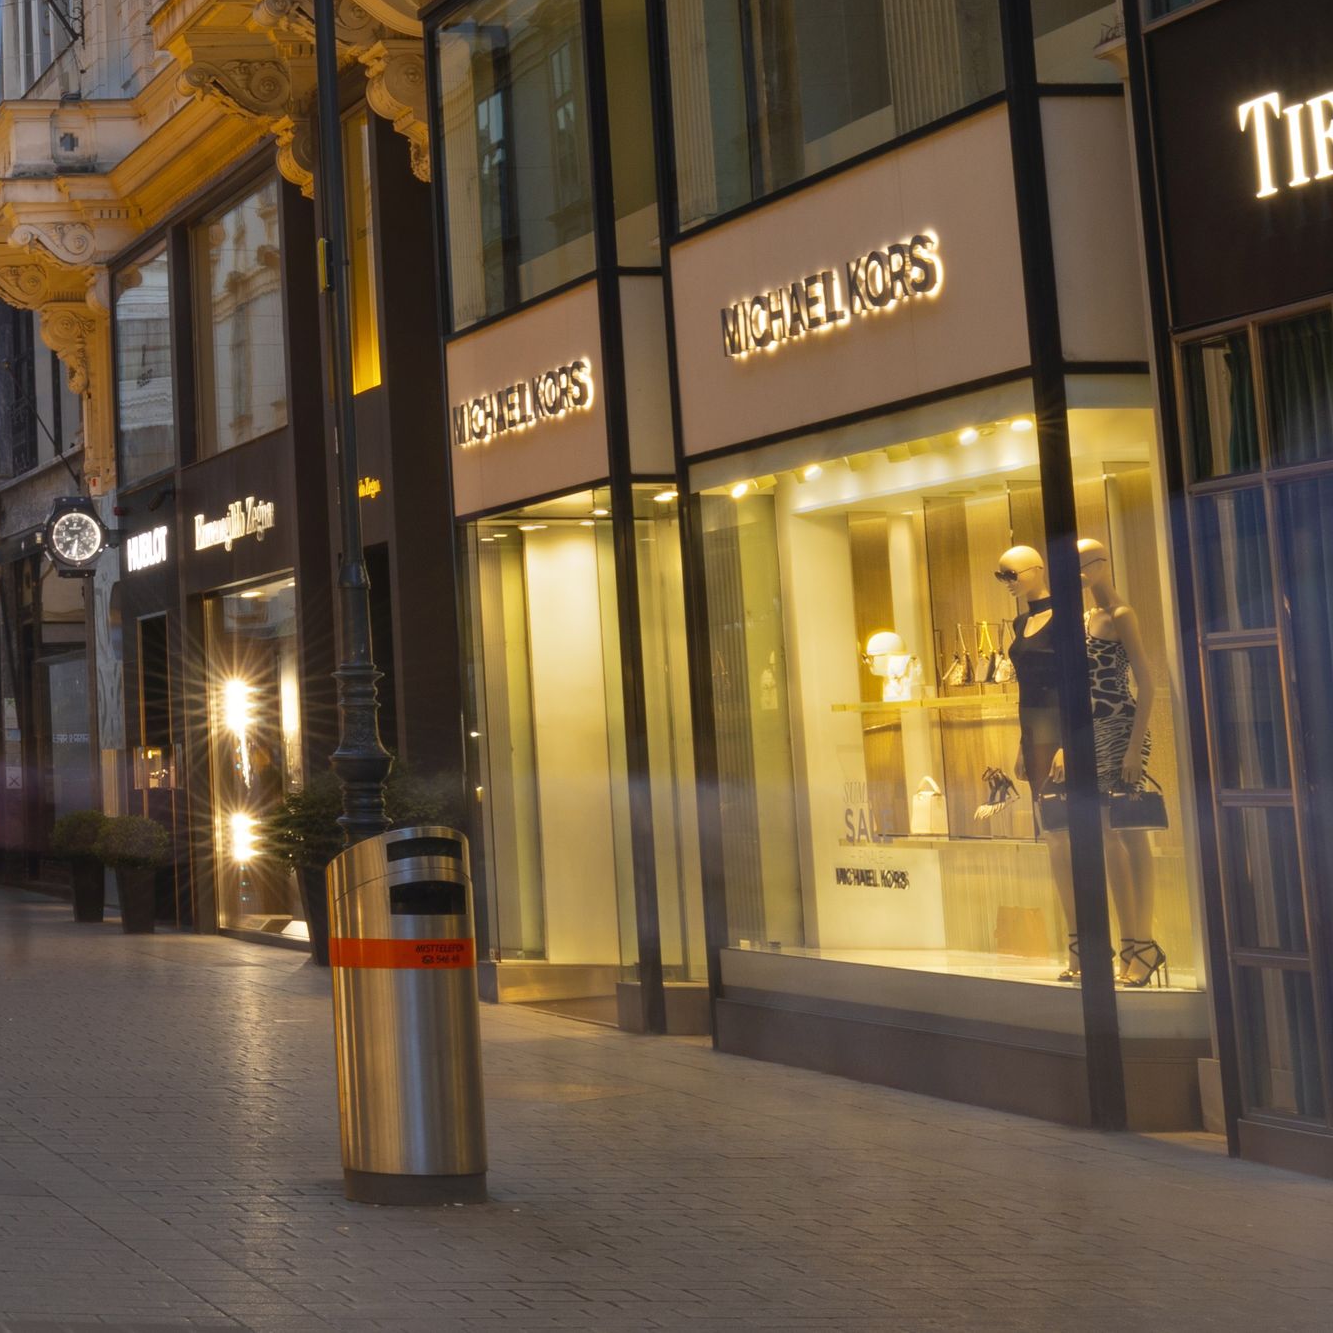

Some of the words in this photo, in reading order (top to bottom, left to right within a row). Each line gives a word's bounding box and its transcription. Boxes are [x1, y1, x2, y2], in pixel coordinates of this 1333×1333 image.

[721, 271, 845, 358] MICHAEL
[846, 235, 939, 315] KORS
[453, 383, 534, 446] MICHAEL
[533, 361, 591, 419] KORS
[245, 496, 275, 542] Zegna
[126, 525, 168, 573] HUBLOT
[844, 808, 894, 844] SALE
[835, 867, 880, 887] MICHAEL
[880, 869, 910, 890] KORS
